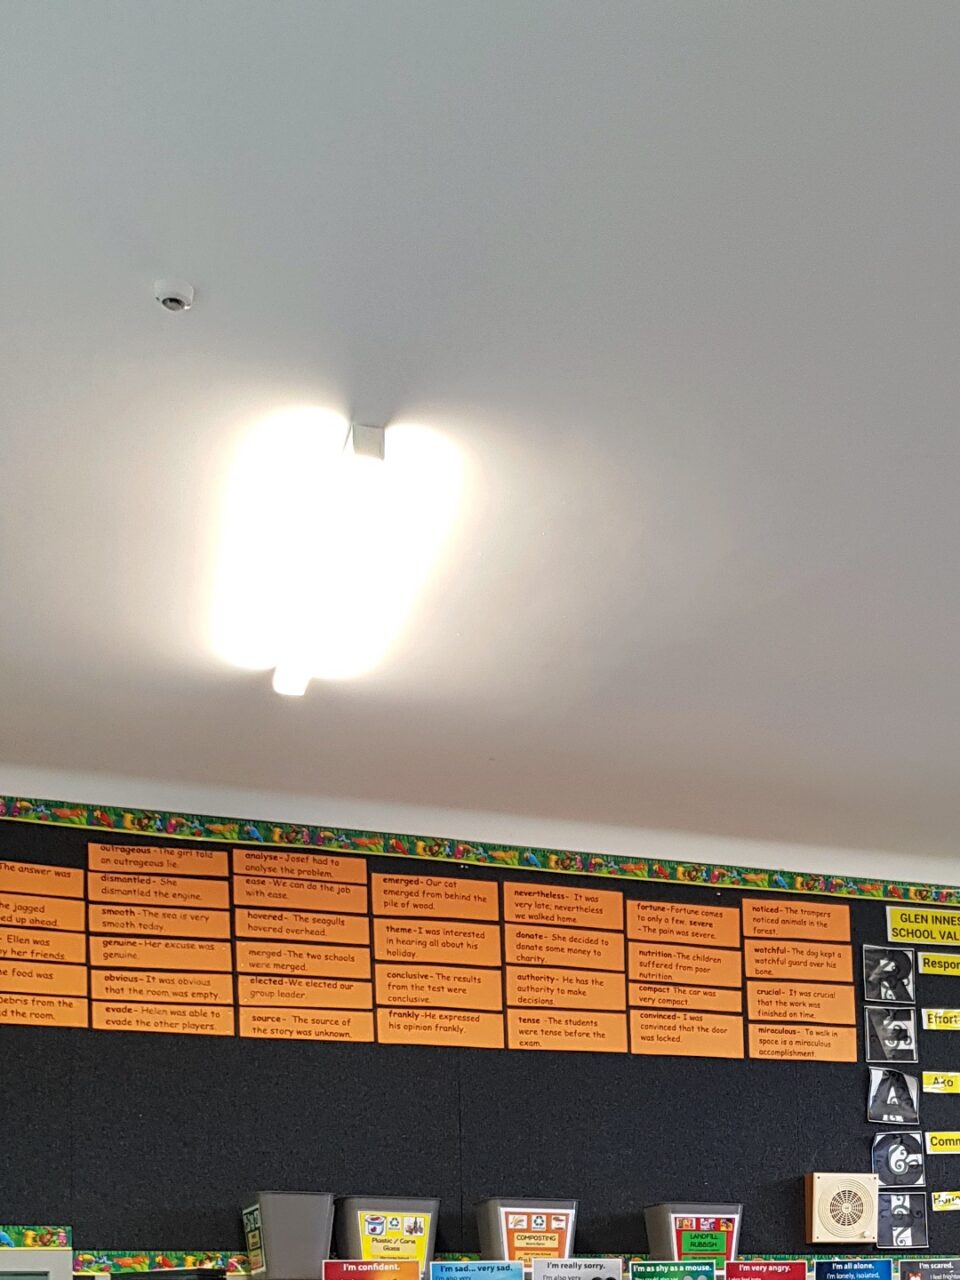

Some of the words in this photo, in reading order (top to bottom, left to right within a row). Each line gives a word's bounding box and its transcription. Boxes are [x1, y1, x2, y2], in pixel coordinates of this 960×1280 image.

[293, 914, 309, 923] The
[312, 917, 345, 926] seagulls
[900, 913, 928, 924] GLEN
[248, 924, 282, 933] hovered
[892, 928, 936, 940] SCHOOL
[807, 949, 818, 958] dog
[820, 950, 835, 958] kept
[640, 961, 672, 969] suffered
[675, 963, 693, 971] from
[576, 977, 588, 985] has
[591, 978, 604, 986] the
[517, 985, 554, 995] authority
[567, 988, 587, 996] make
[136, 1018, 151, 1026] the
[270, 1028, 293, 1036] story
[315, 1030, 352, 1038] unknown.
[656, 1265, 668, 1273] shy
[769, 1265, 790, 1273] angry.
